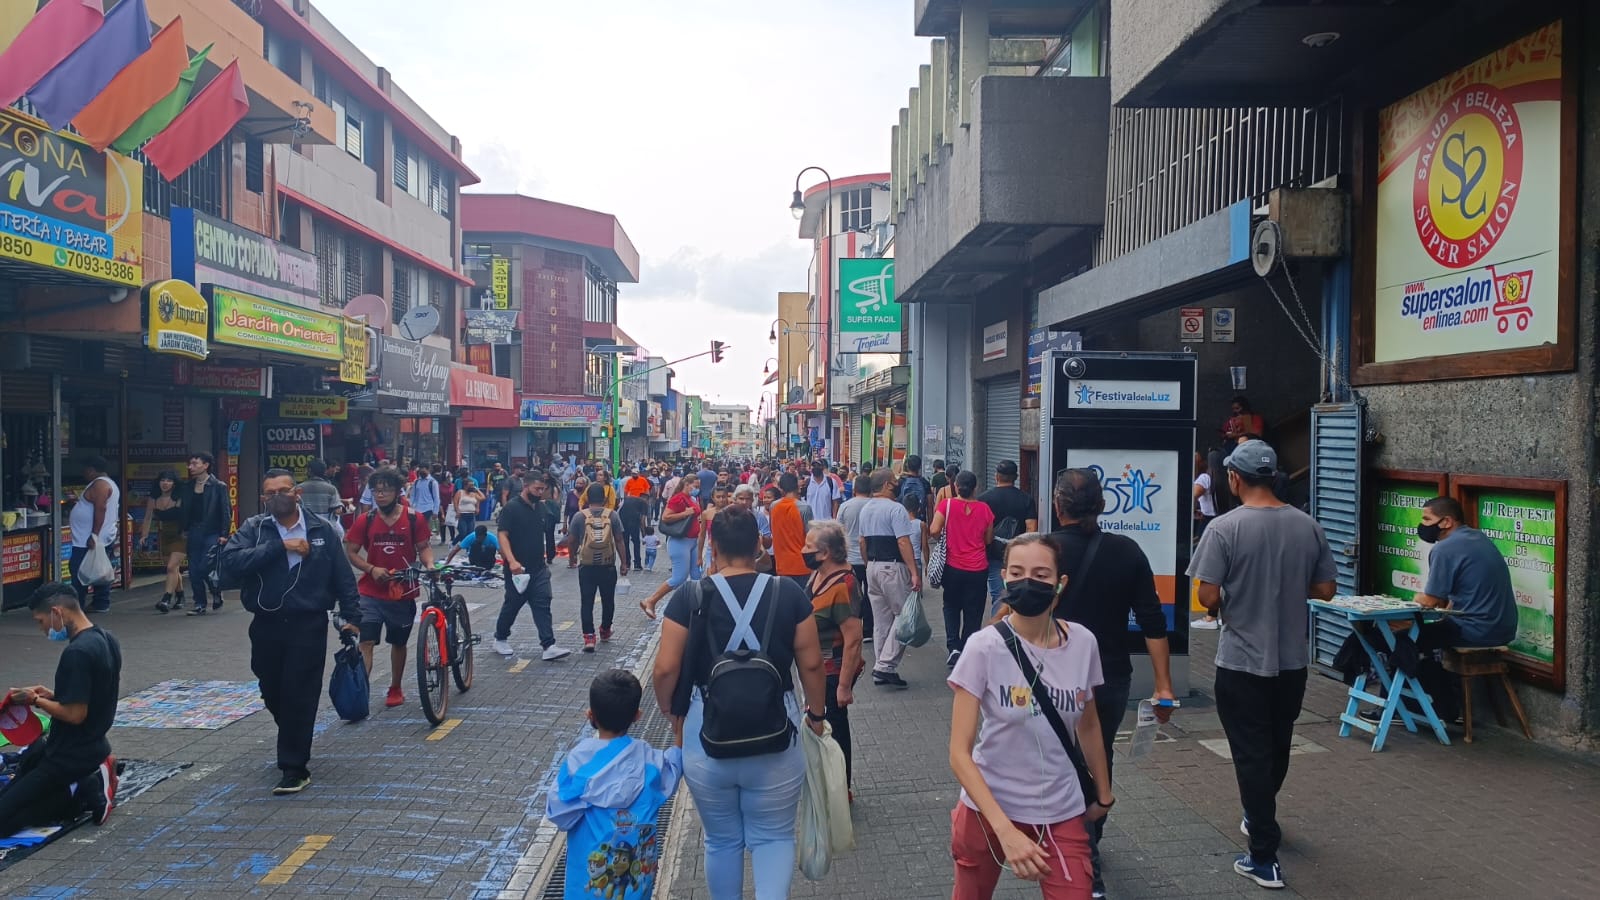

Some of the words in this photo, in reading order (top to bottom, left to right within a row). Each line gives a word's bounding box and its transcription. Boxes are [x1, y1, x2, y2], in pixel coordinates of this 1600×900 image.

[1419, 114, 1448, 180] SALUD
[1452, 101, 1460, 113] Y
[1466, 92, 1517, 149] BELLEZA
[0, 118, 87, 178] ZONA
[1417, 205, 1459, 263] SUPER
[1467, 180, 1517, 259] SALON
[54, 226, 62, 241] Y
[65, 229, 108, 255] BAZAR
[195, 219, 236, 268] CENTRO
[237, 235, 279, 280] COPIADO
[67, 251, 134, 281] 7093-9386
[1402, 277, 1491, 319] supersalon
[1405, 282, 1425, 294] www.
[175, 302, 207, 328] Imperial
[847, 315, 873, 323] SUPER
[874, 315, 896, 323] FACIL
[1423, 306, 1489, 331] enlinea.com
[224, 308, 280, 334] Jardín
[282, 320, 338, 346] Oriental
[853, 332, 890, 352] Tropical
[465, 379, 474, 397] LA
[474, 380, 498, 401] FAVORITA
[316, 397, 337, 405] POOL
[267, 428, 316, 441] COPIAS
[269, 454, 315, 467] FOTOS
[1483, 501, 1494, 517] JJ
[1100, 520, 1161, 531] tivaldelaLuz
[1378, 522, 1396, 532] VENTA
[1506, 531, 1512, 540] Y
[1406, 538, 1416, 547] DE
[1516, 545, 1528, 556] DE
